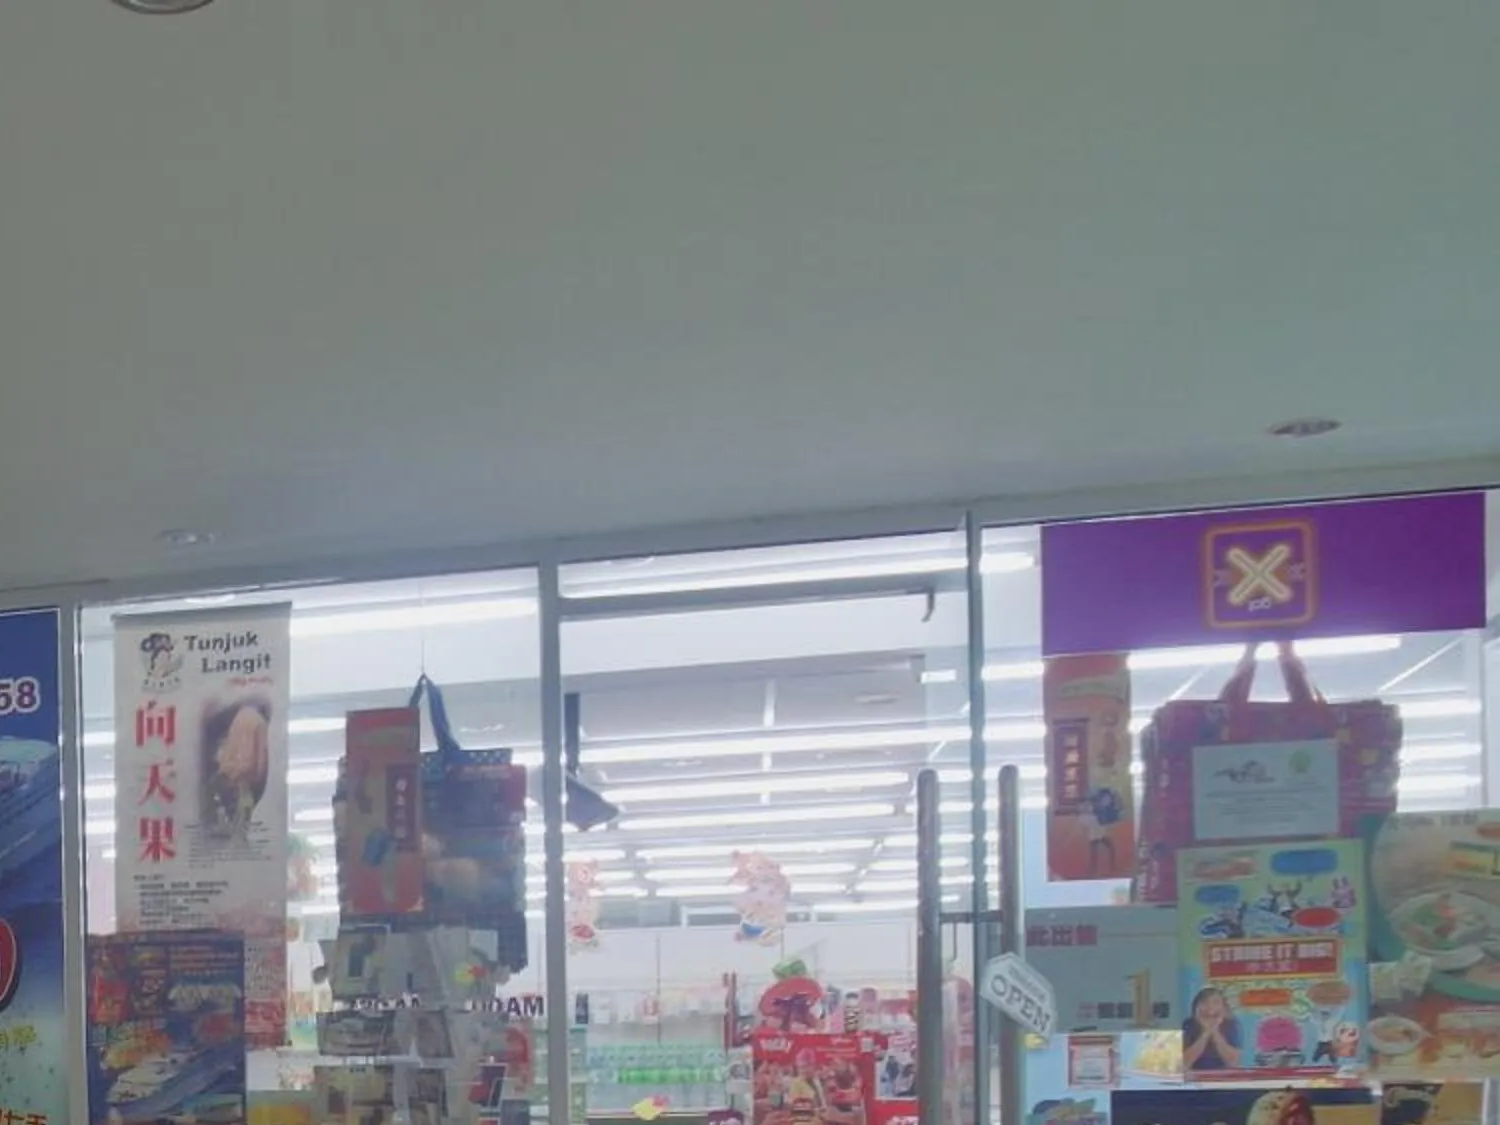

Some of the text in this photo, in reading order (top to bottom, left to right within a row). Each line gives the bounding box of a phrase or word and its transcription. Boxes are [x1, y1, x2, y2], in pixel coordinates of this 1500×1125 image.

[185, 631, 258, 652] Tunjuk
[202, 653, 272, 674] Langit
[135, 699, 177, 864] 向天果
[990, 973, 1050, 1032] OPEN
